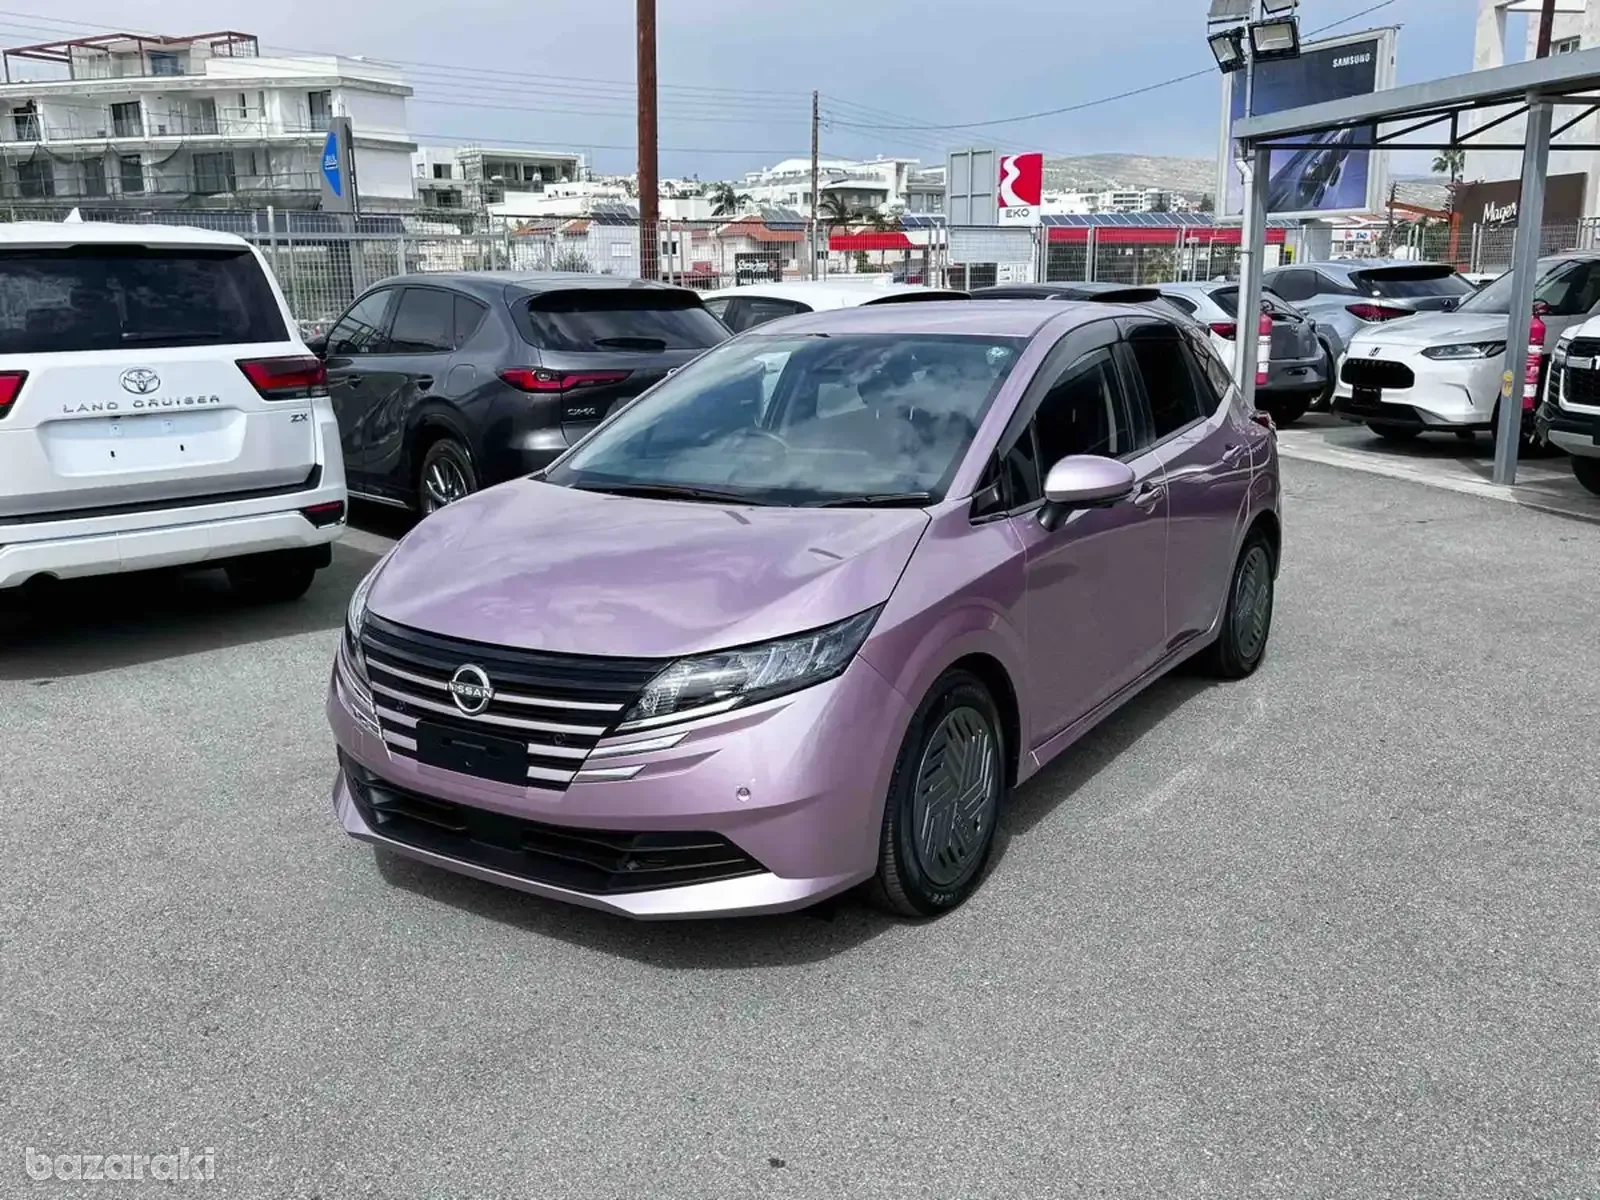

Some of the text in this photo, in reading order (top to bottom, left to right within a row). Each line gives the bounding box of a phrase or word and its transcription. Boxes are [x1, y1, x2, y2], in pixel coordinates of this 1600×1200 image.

[1332, 53, 1370, 68] SAMSUNG
[1005, 208, 1030, 218] EKO
[63, 394, 221, 414] LAND CRUISER
[290, 412, 309, 424] ZX
